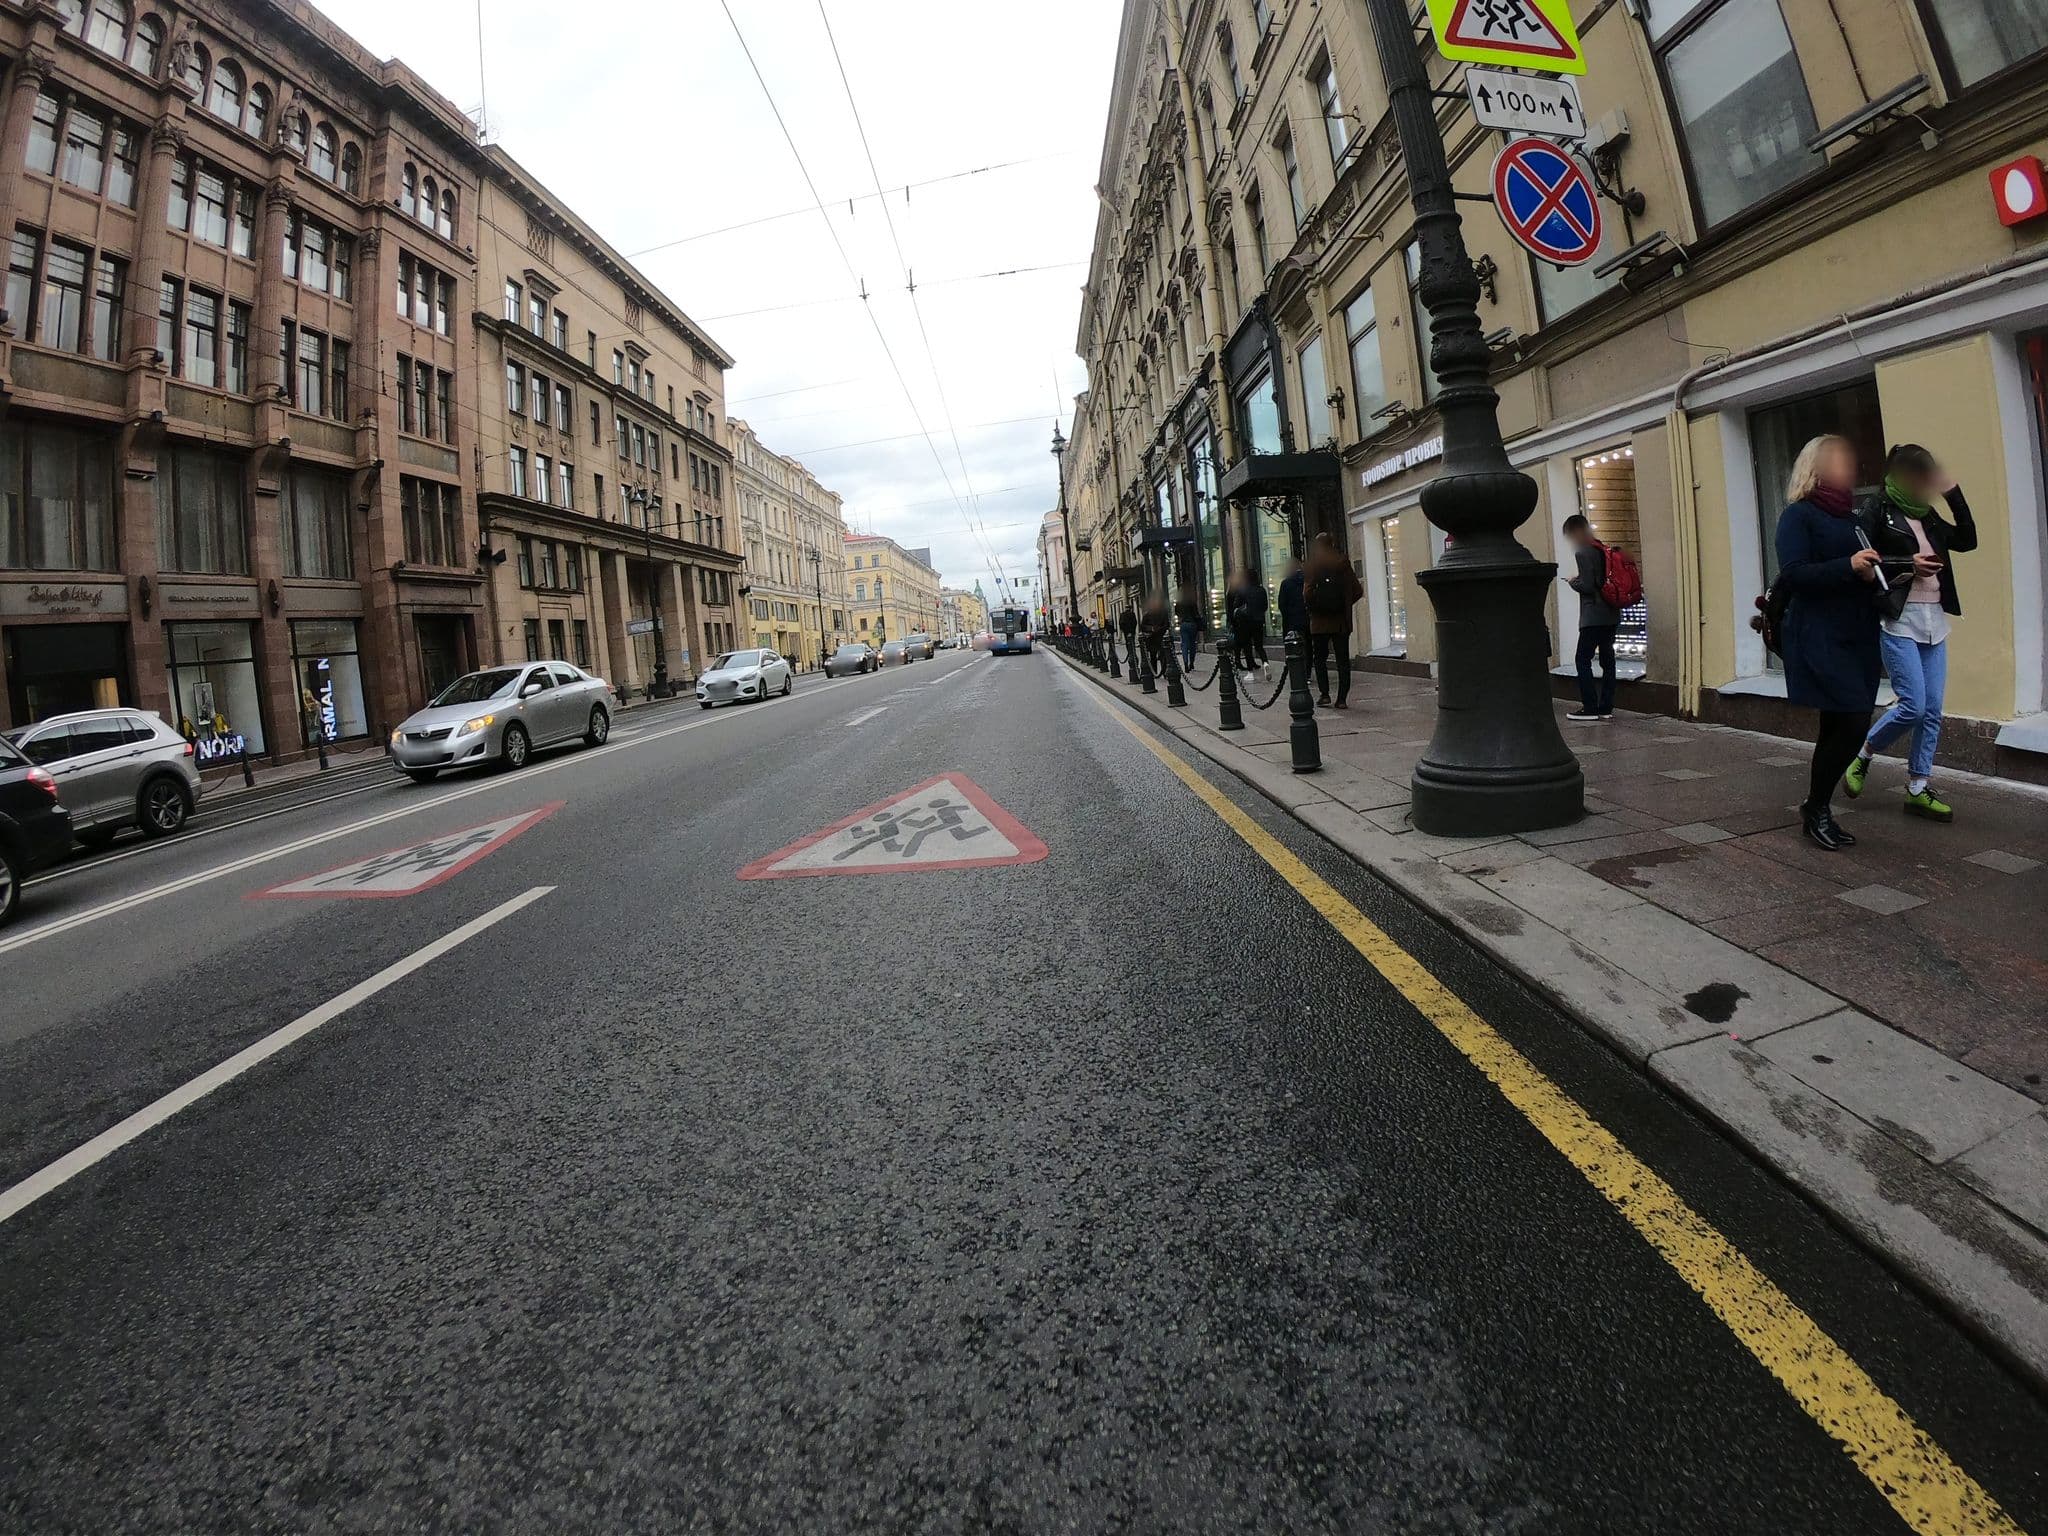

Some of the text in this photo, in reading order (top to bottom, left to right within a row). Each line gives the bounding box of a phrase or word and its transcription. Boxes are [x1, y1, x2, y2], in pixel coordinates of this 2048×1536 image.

[1496, 90, 1536, 114] 100
[1361, 454, 1402, 488] FOODSHOP
[320, 680, 337, 741] RMAL
